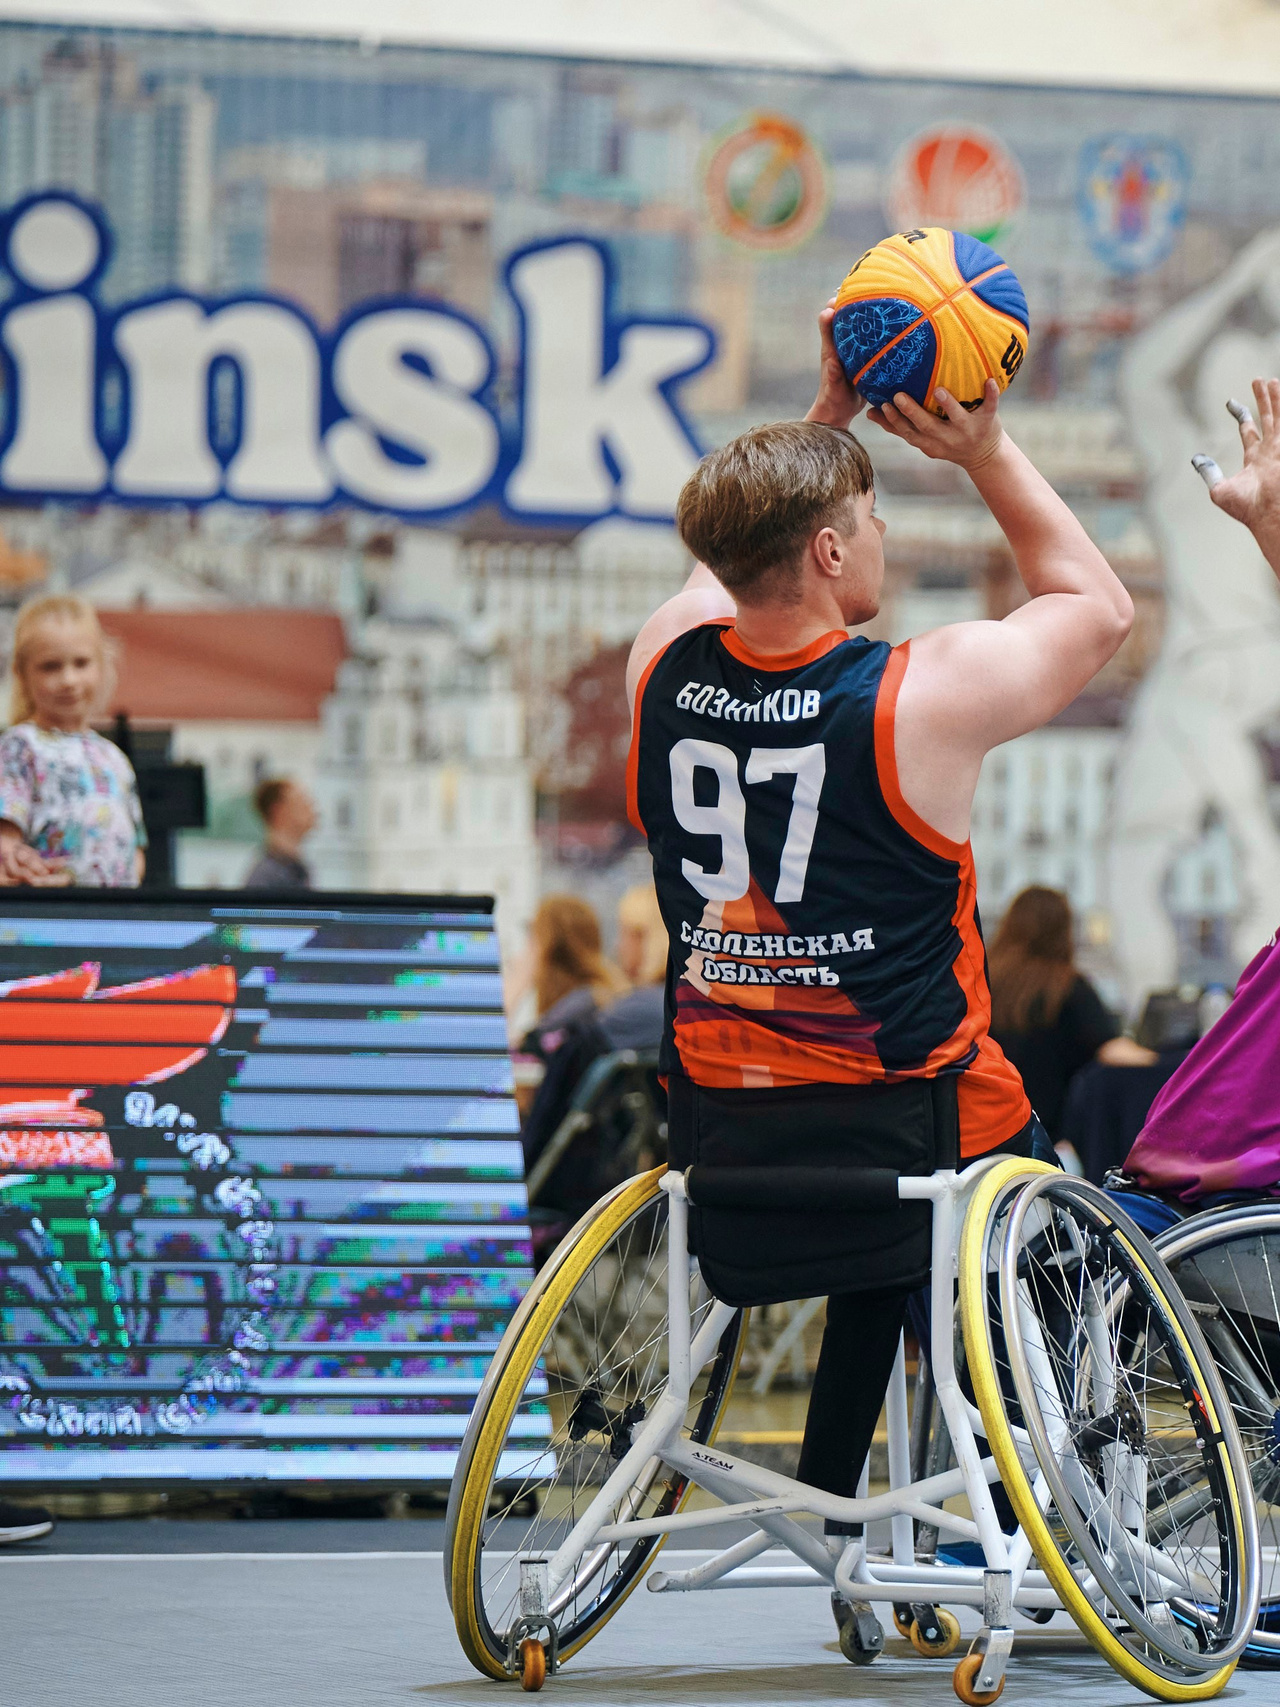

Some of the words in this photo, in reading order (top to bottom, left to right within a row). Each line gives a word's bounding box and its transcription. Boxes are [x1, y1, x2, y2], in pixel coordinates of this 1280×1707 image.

[0, 195, 712, 518] insk
[669, 738, 826, 903] 97
[702, 957, 840, 986] ОБЛАСТЬ
